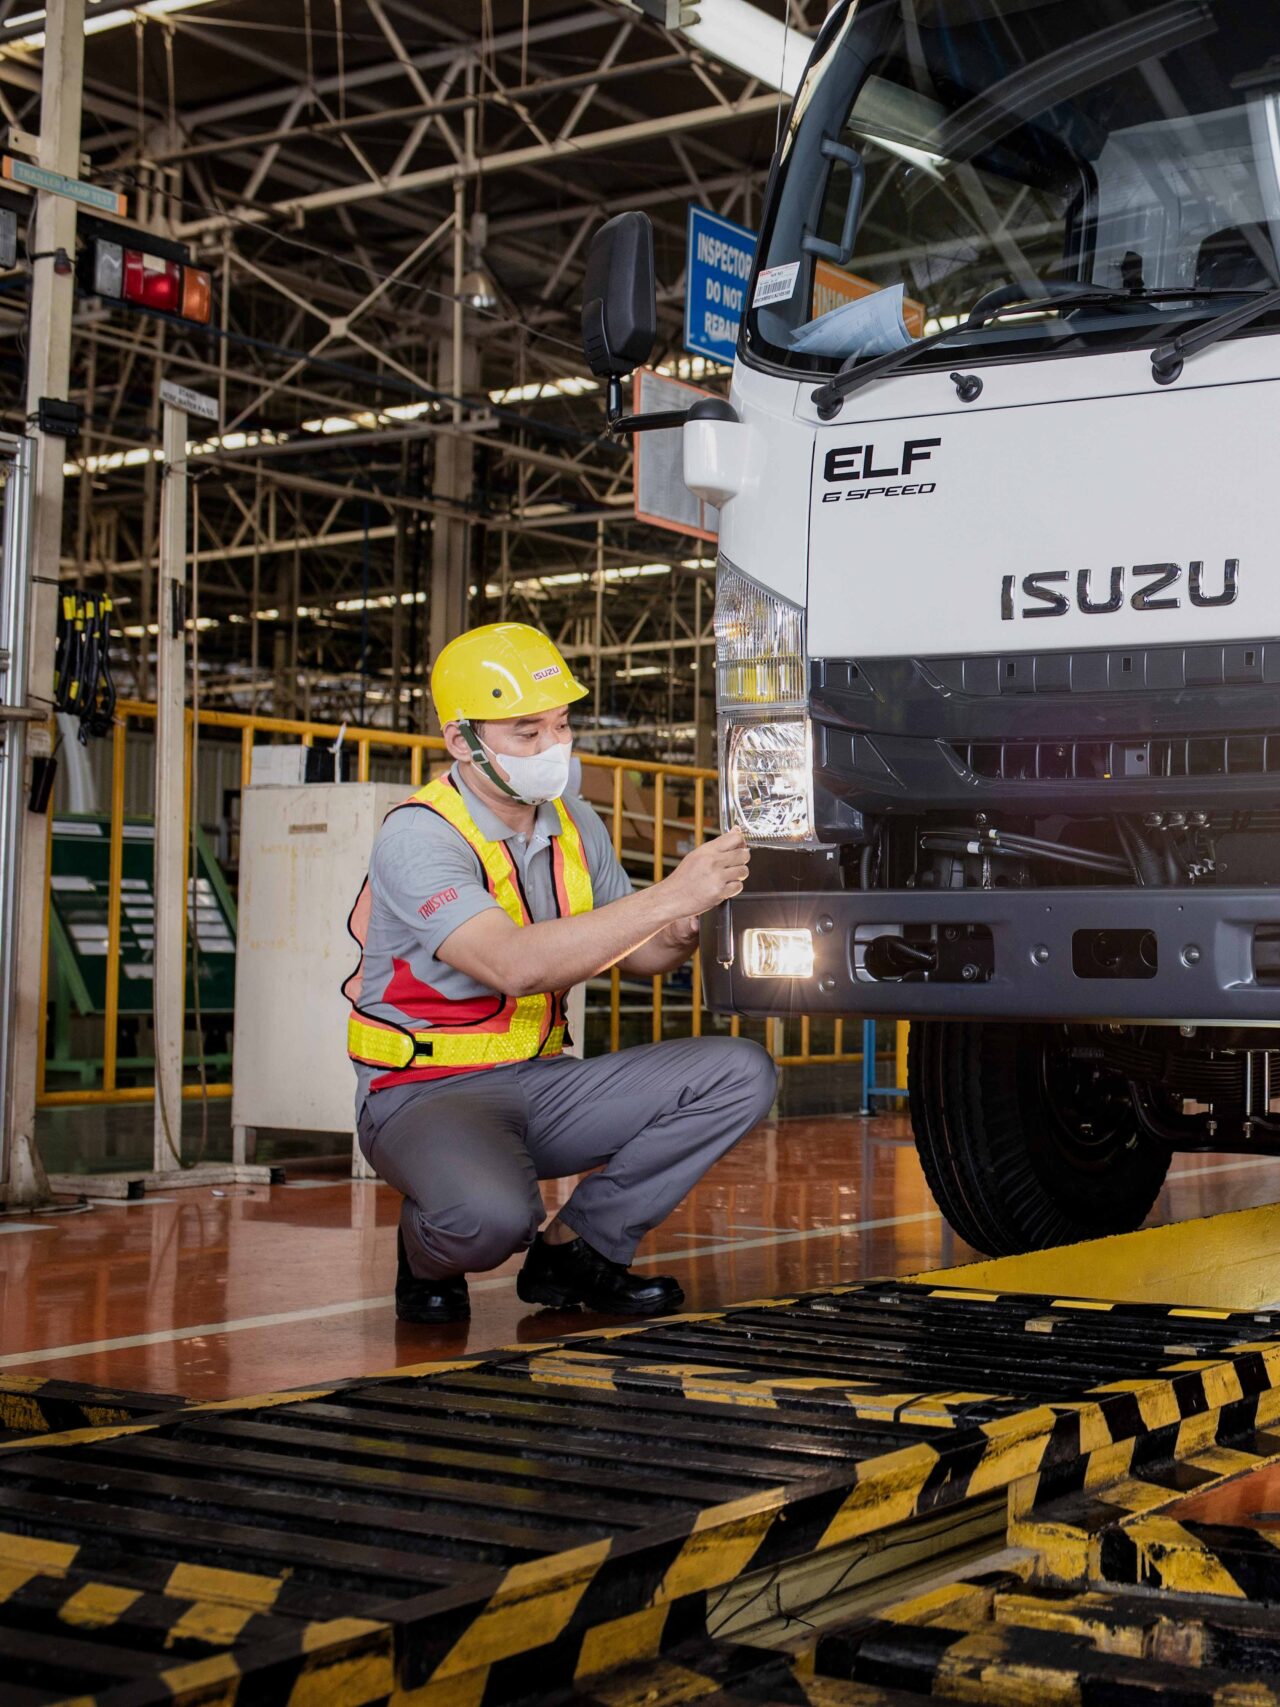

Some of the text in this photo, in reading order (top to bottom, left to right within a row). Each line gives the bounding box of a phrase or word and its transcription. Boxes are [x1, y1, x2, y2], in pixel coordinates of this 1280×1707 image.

[697, 232, 753, 281] INSPECTOR
[706, 278, 721, 304] DO
[722, 284, 742, 312] NOT
[823, 437, 942, 483] ELF
[845, 483, 936, 501] SPEED
[1001, 558, 1239, 621] ISUZU
[533, 666, 560, 680] ISUZU
[417, 887, 458, 920] TRUSTED
